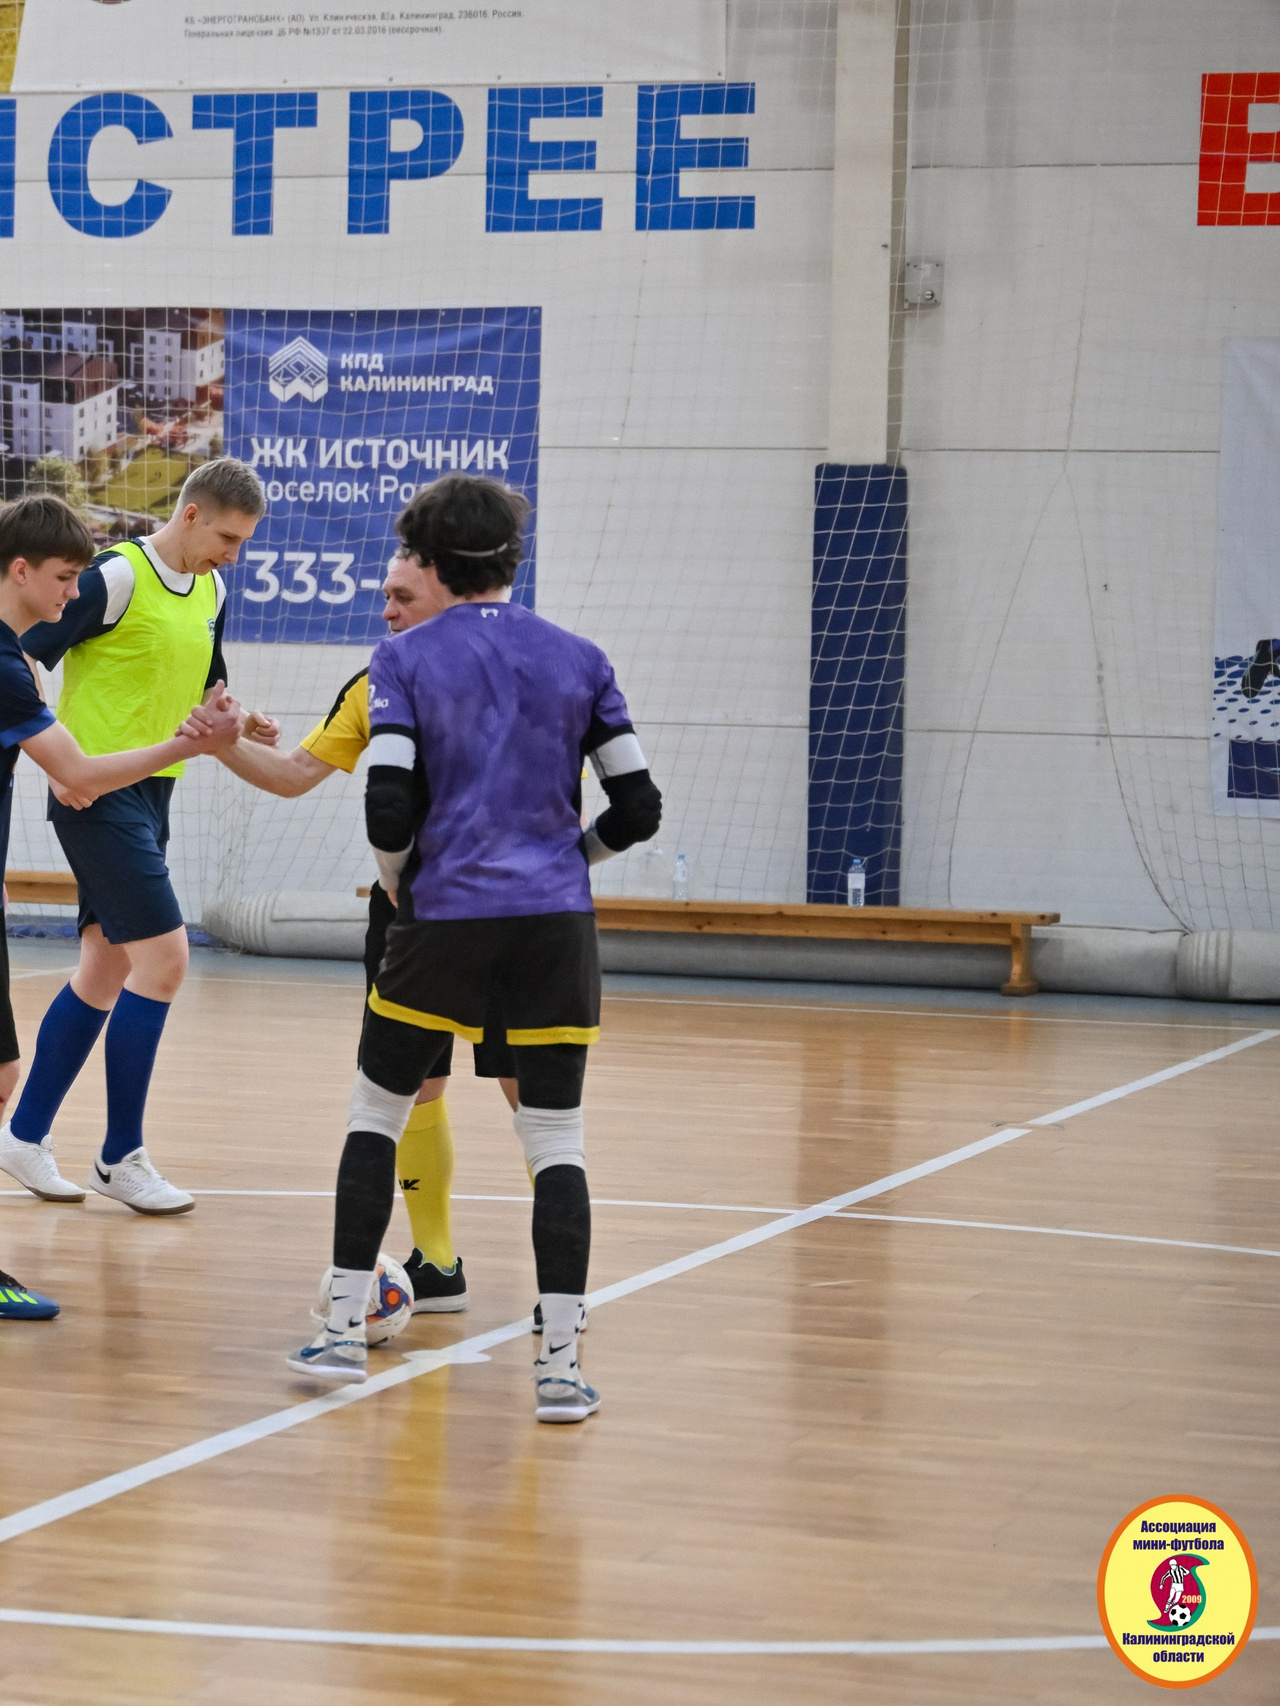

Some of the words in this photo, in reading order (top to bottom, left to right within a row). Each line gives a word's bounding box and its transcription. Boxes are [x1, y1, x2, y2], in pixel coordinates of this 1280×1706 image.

[340, 352, 384, 373] КПД
[340, 374, 495, 396] КАЛИНИНГРАД
[250, 436, 309, 468] ЖК
[319, 437, 510, 471] ИСТОЧНИК
